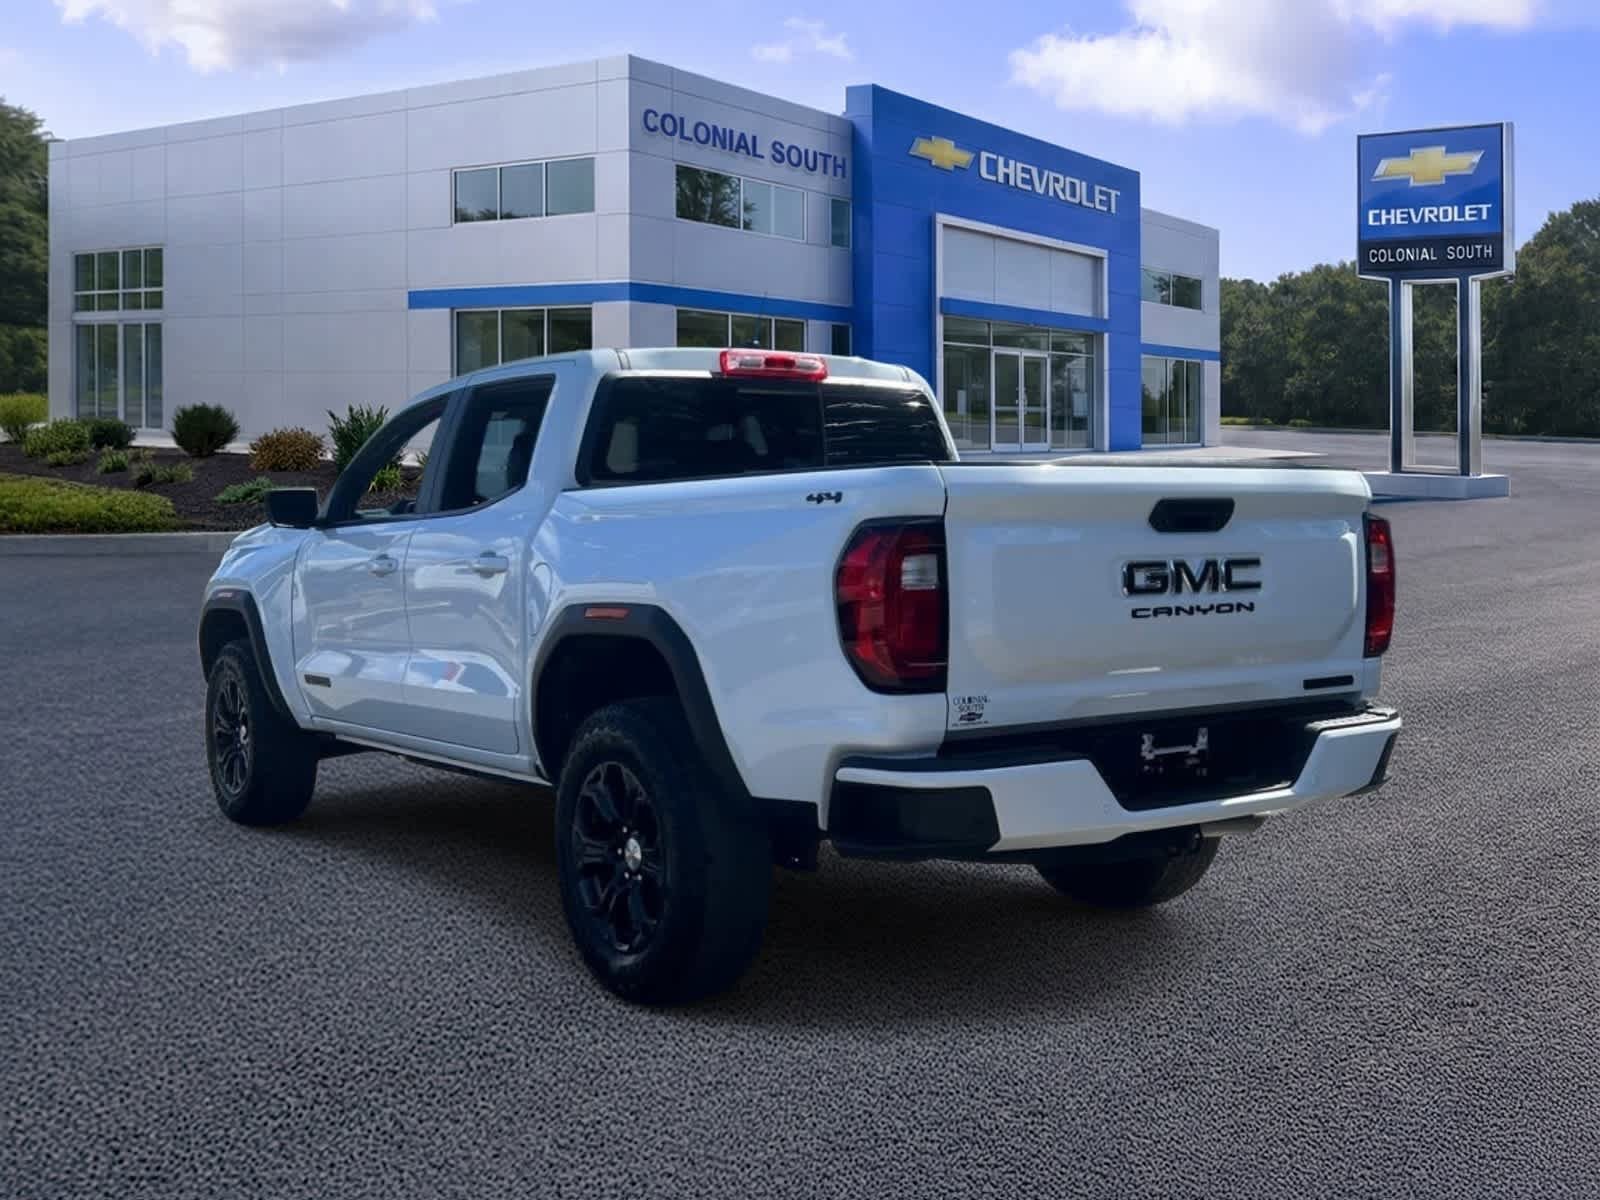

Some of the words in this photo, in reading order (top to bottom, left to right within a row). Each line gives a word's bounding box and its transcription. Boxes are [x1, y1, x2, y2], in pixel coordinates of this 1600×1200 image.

[643, 108, 764, 158] COLONIAL
[771, 140, 847, 178] SOUTH
[979, 151, 1120, 213] CHEVROLET
[1368, 204, 1492, 225] CHEVROLET
[1369, 248, 1437, 263] COLONIAL
[1447, 245, 1493, 260] SOUTH
[1122, 557, 1262, 597] GMC
[1131, 602, 1255, 619] CANYON
